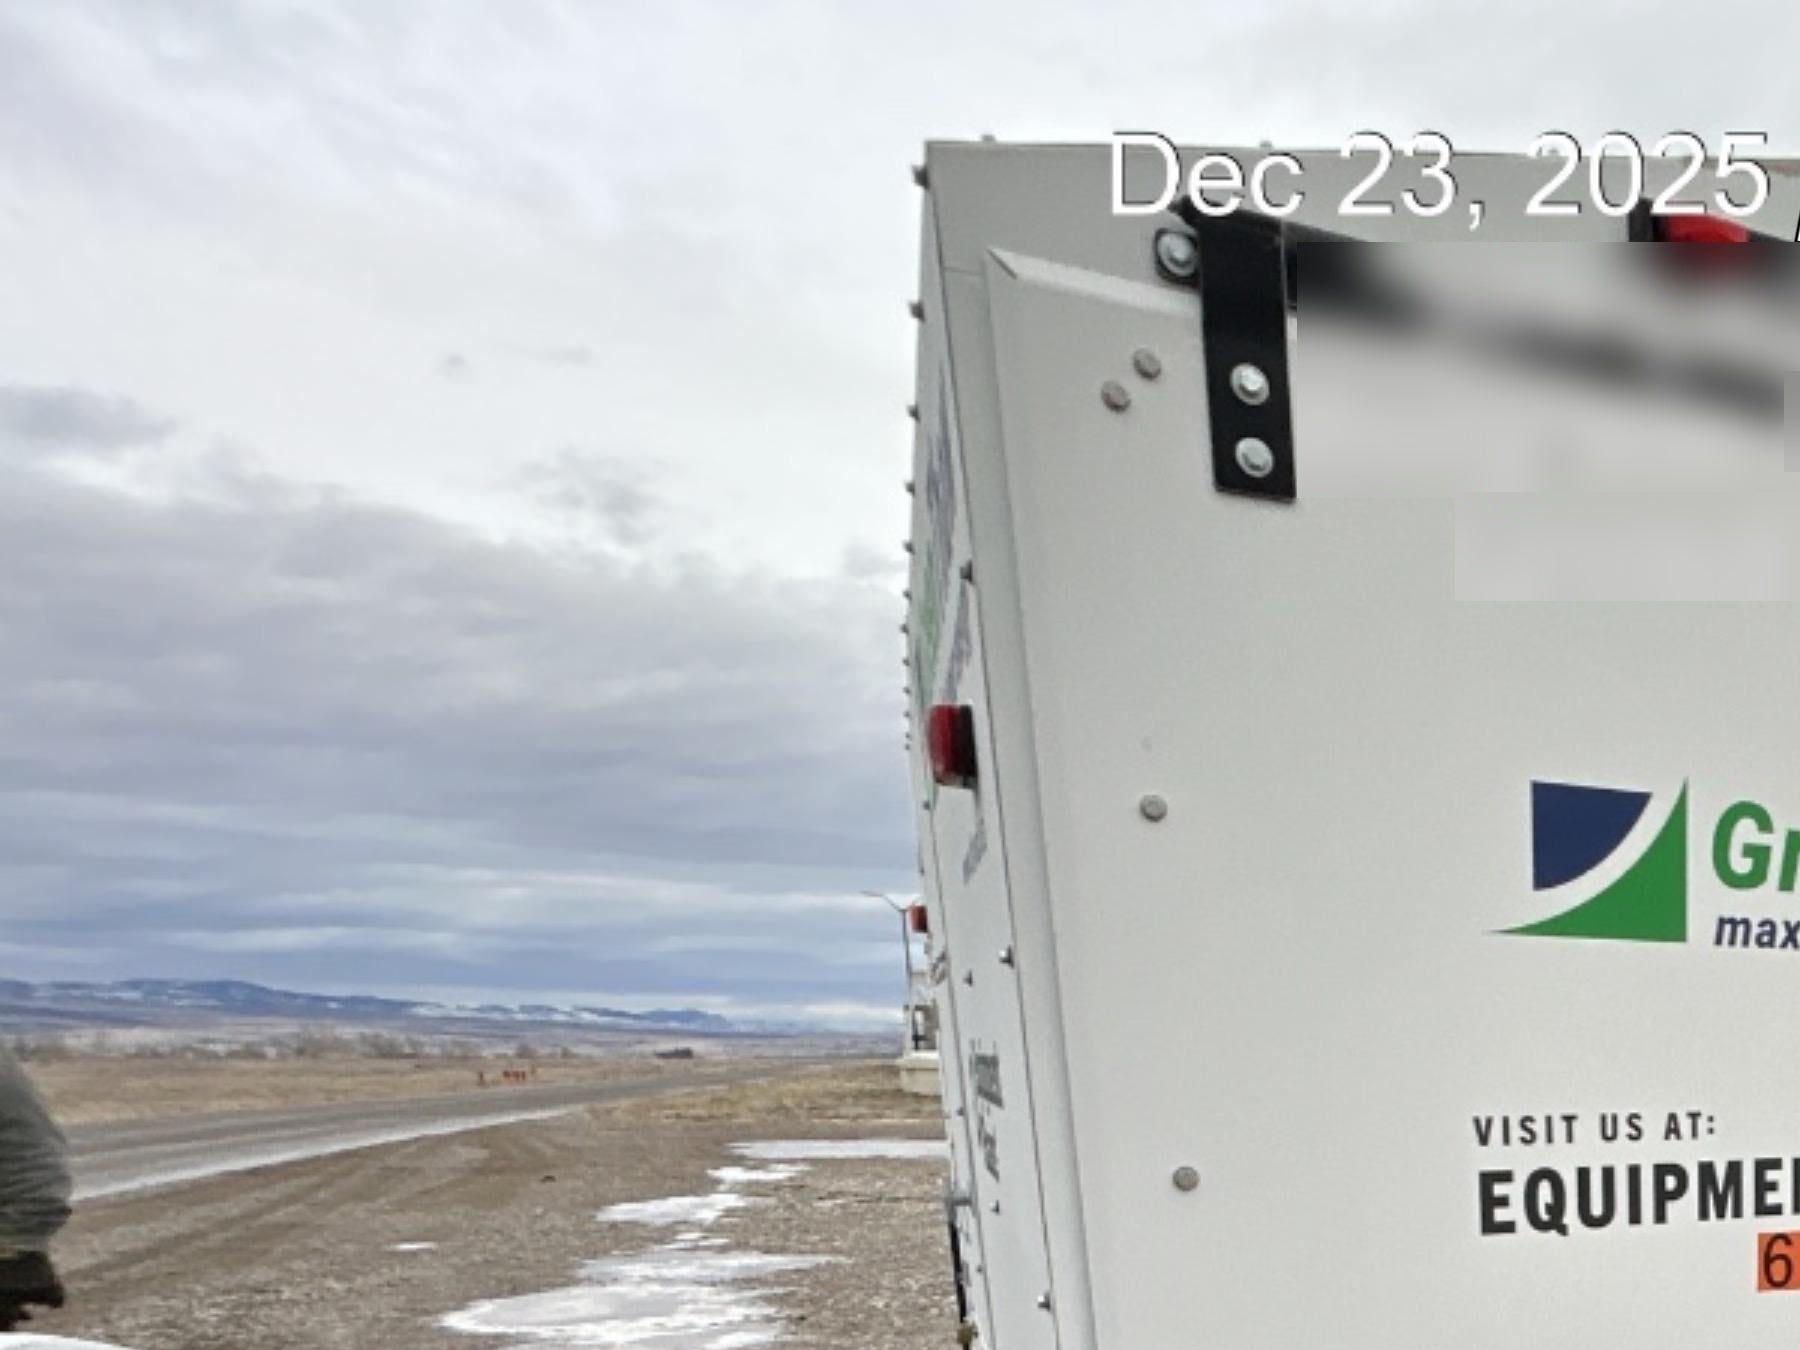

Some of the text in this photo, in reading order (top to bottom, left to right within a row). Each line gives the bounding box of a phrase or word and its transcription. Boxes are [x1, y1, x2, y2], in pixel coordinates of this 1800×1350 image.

[1473, 1110, 1717, 1147] VISIT US AT:
